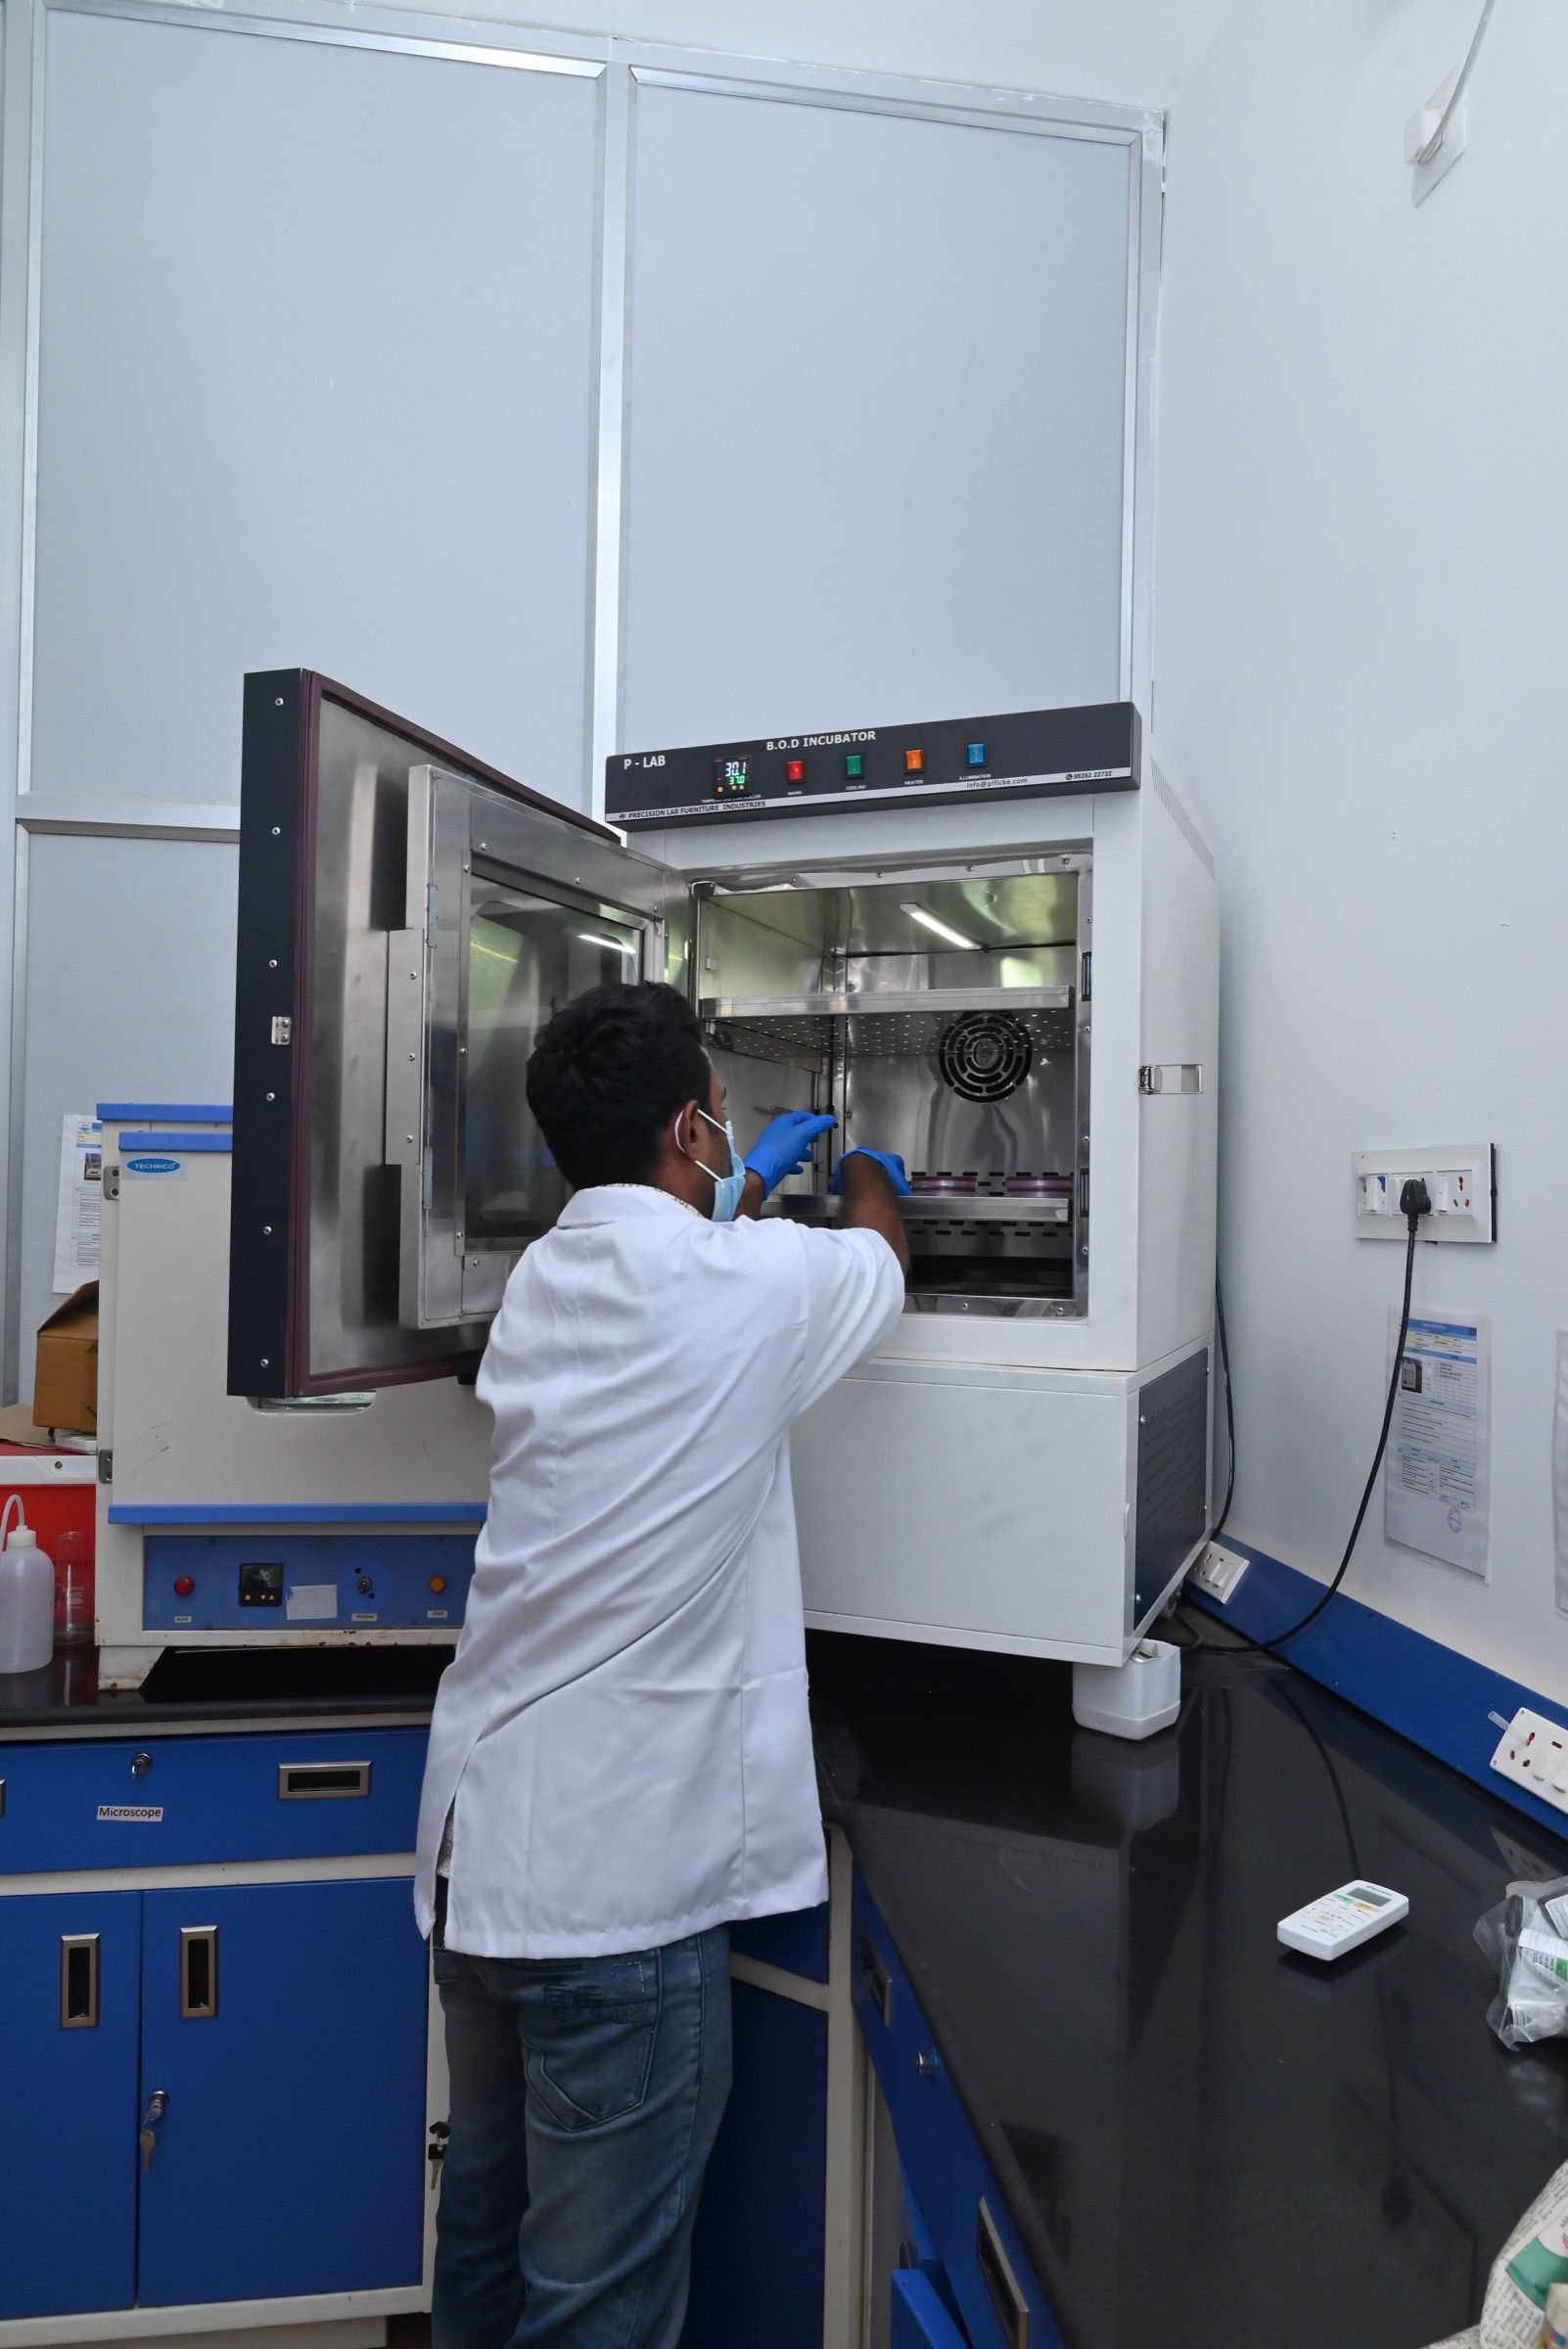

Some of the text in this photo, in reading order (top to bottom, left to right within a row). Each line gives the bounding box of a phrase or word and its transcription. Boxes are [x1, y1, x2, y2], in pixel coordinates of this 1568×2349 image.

[766, 730, 876, 751] B.O.D INCUBATOR
[623, 759, 632, 770] P
[643, 755, 667, 768] LAB
[627, 801, 766, 818] PRECISION LAB FURNITURE INDUSTRIES
[99, 1807, 161, 1819] Microscope
